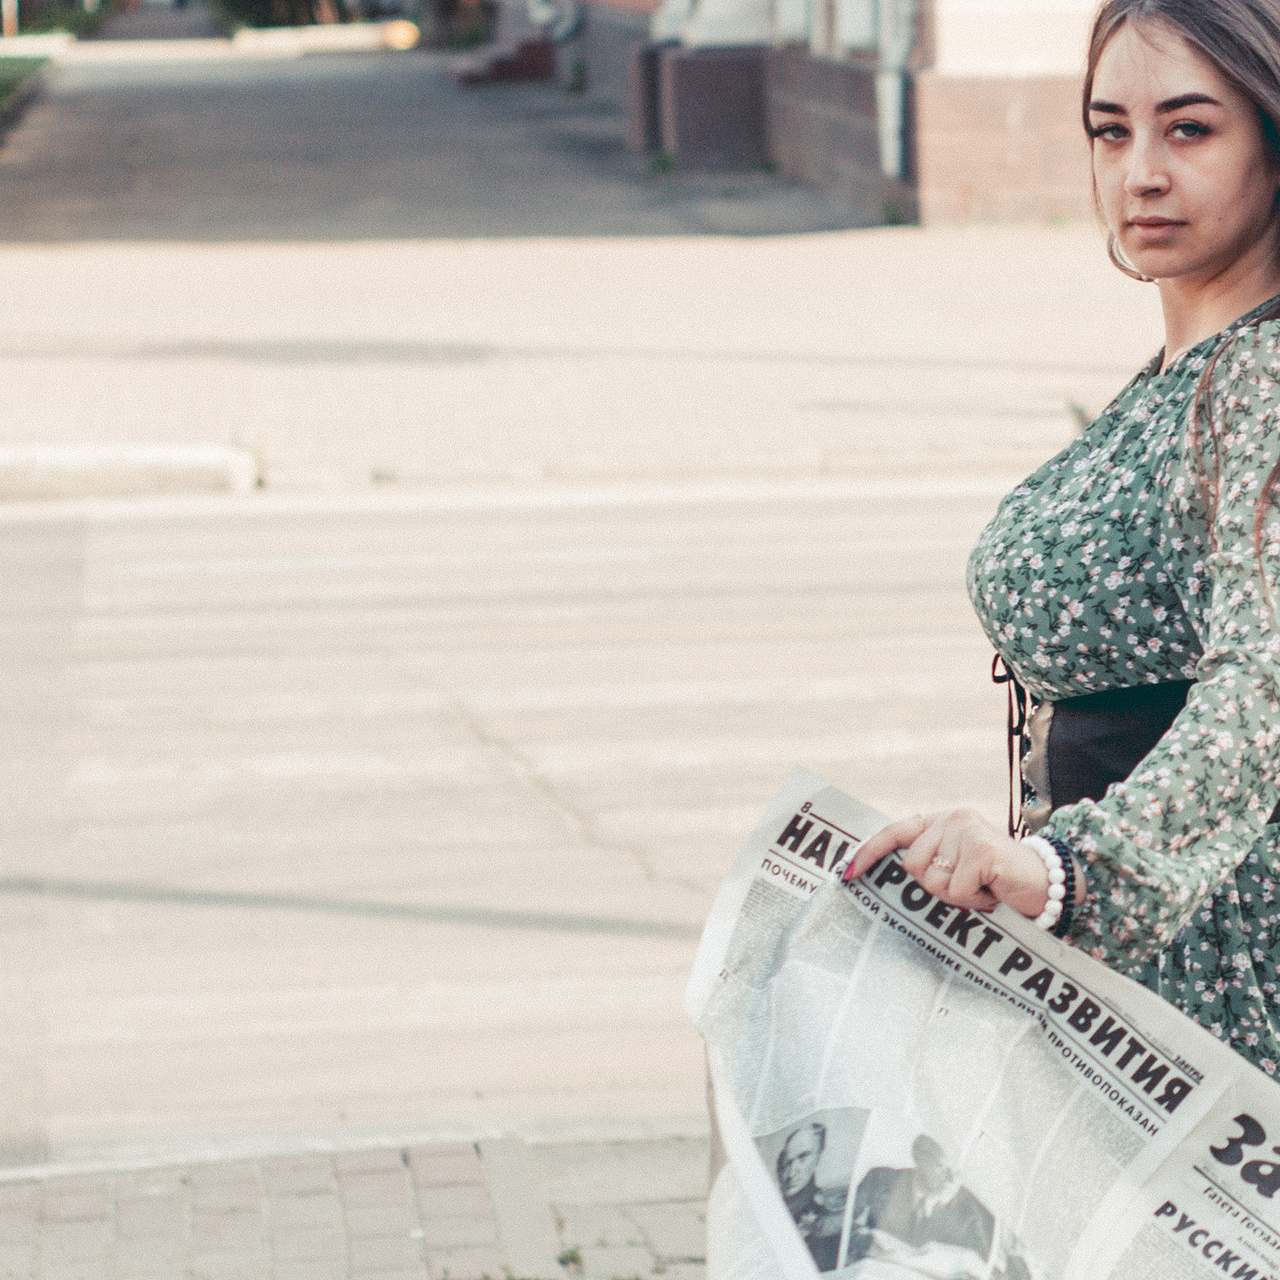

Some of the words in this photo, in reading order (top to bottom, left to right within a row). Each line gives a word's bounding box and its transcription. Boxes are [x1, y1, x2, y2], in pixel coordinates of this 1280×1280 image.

[800, 801, 813, 814] 8
[760, 858, 818, 894] ПОЧЕМУ
[881, 912, 963, 971] ЭКОНОМИКЕ
[1048, 1031, 1160, 1137] ПРОТИВОПОКАЗАН
[865, 853, 1004, 959] РОЕКТ
[999, 946, 1194, 1114] РАЗВИТИЯ
[1203, 1186, 1240, 1218] Газета
